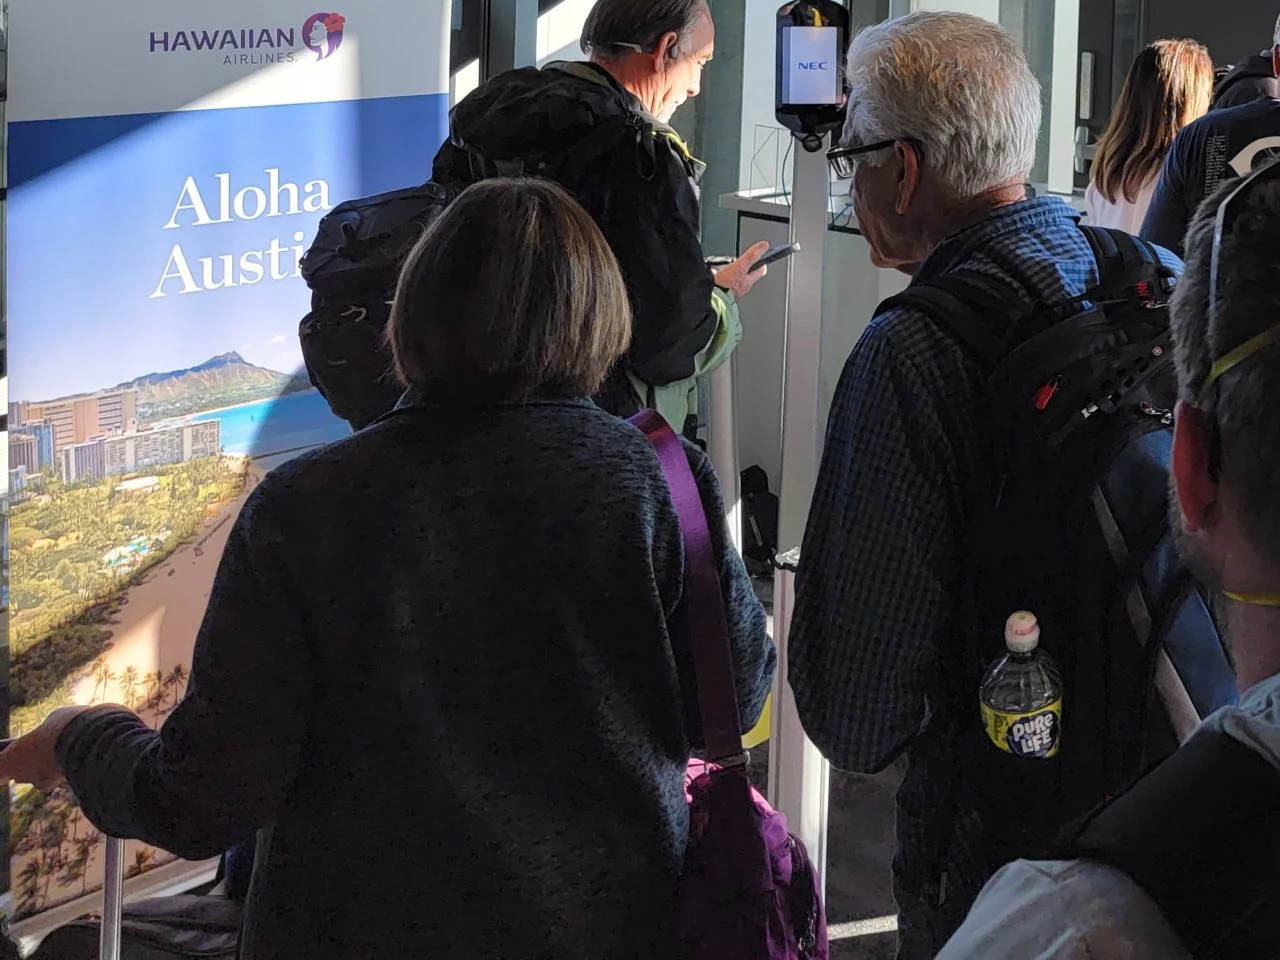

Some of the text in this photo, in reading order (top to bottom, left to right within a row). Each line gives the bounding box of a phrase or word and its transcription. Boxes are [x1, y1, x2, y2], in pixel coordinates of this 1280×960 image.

[149, 27, 296, 53] HAWAIIAN
[798, 62, 828, 70] NEC
[162, 167, 332, 230] Aloha
[149, 231, 305, 299] Austi
